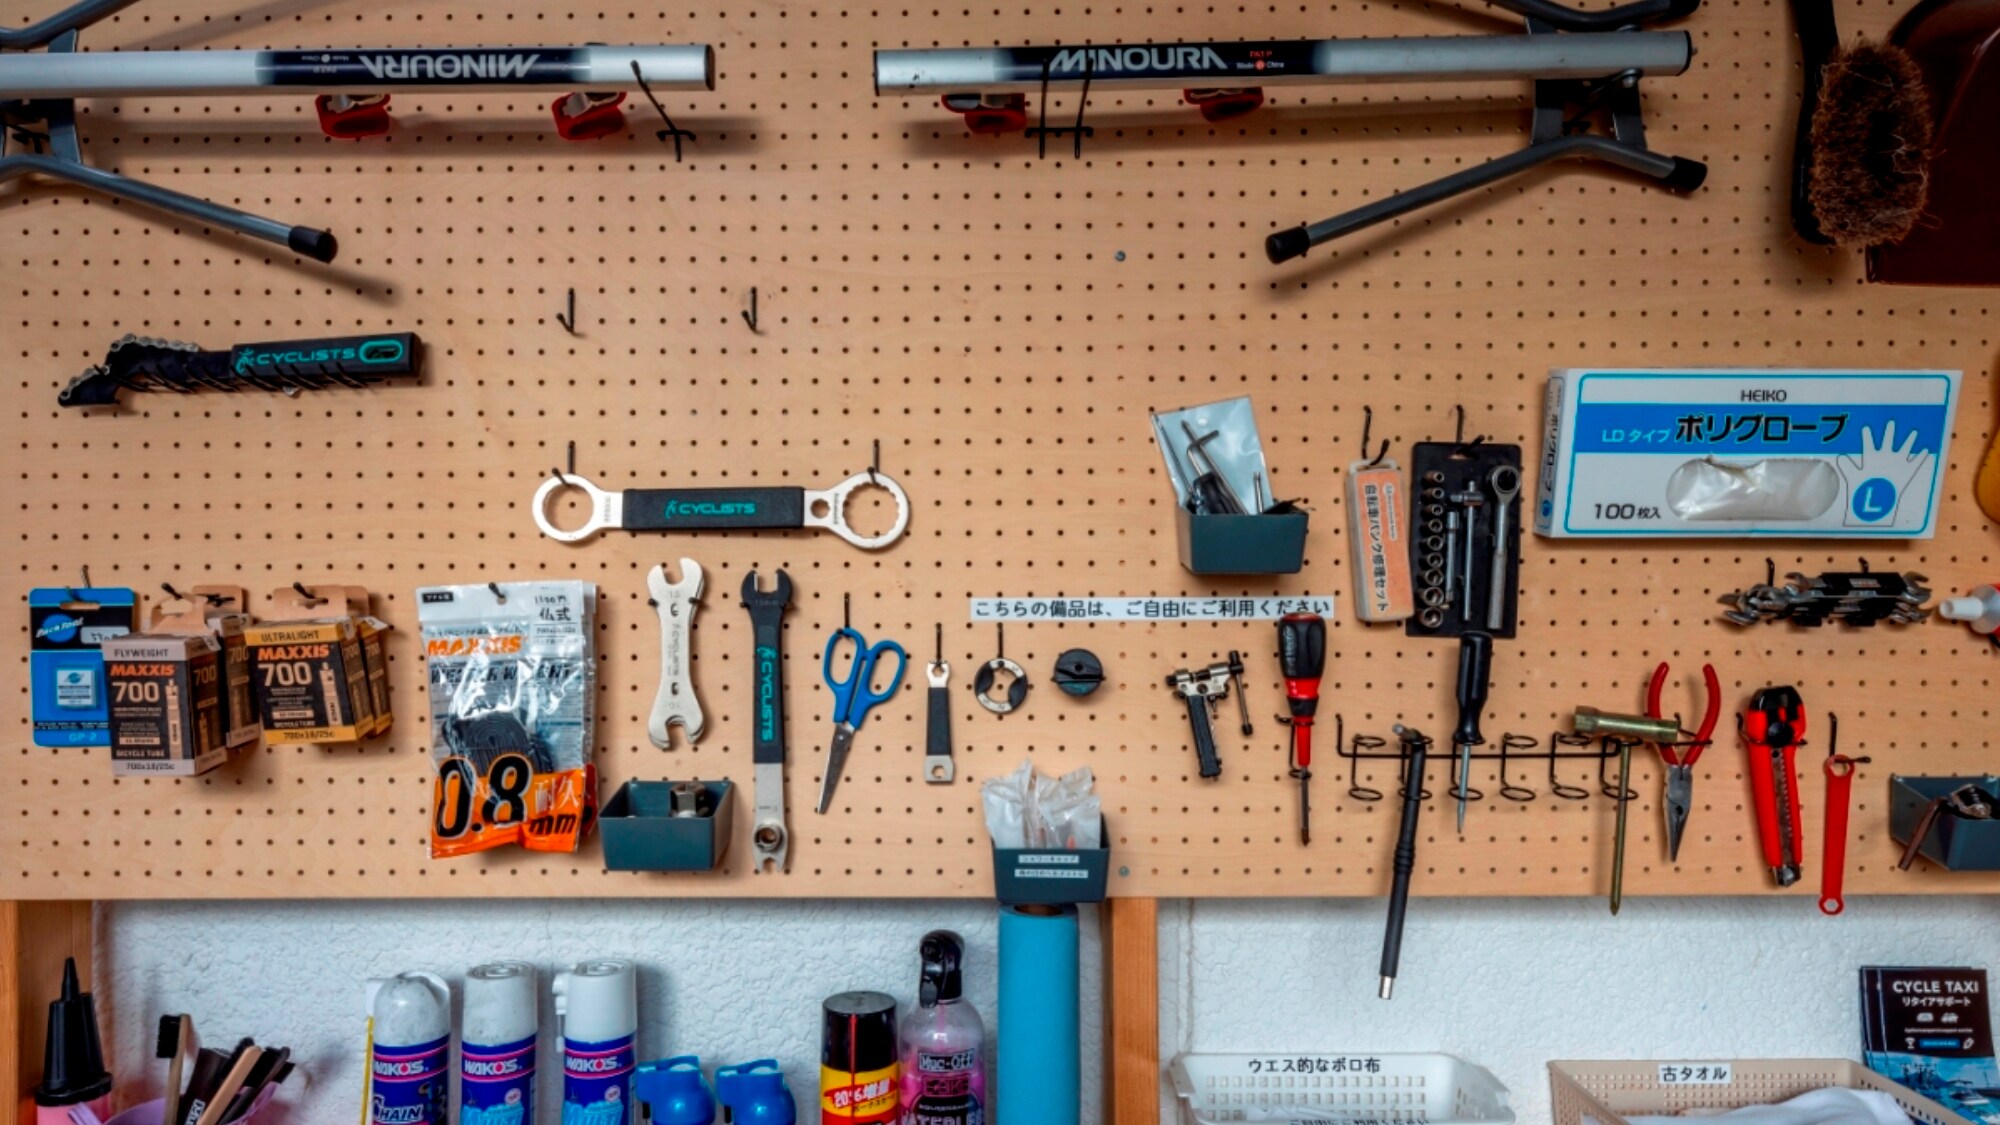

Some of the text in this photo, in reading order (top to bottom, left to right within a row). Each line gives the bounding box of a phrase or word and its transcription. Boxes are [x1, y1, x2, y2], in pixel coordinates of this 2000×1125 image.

[358, 53, 540, 79] MINOURA
[1049, 46, 1228, 72] MINOURA
[256, 348, 355, 366] CYCLISTS
[1740, 389, 1788, 403] HEIKO
[1601, 427, 1672, 444] LD タイプ
[1675, 412, 1851, 445] ポリグローブ
[1863, 486, 1884, 513] L
[679, 502, 756, 516] CYCLISTS
[261, 630, 320, 643] ULTRALIGHT
[113, 648, 169, 658] FLYWEIGHT
[257, 643, 330, 662] MAXXIS
[110, 664, 176, 677] MAXXIS
[193, 665, 217, 686] 700
[257, 661, 313, 687] 700
[112, 681, 160, 703] 700
[761, 661, 773, 741] CYCLISTS
[435, 753, 578, 841] 0.8 mm
[534, 776, 580, 815] 耐久
[1892, 980, 1980, 993] CYCLE TAXI
[1902, 995, 1972, 1007] リタイアサポート
[1248, 1057, 1381, 1074] ウエス的なボロ布
[1661, 1066, 1729, 1081] 古タオル
